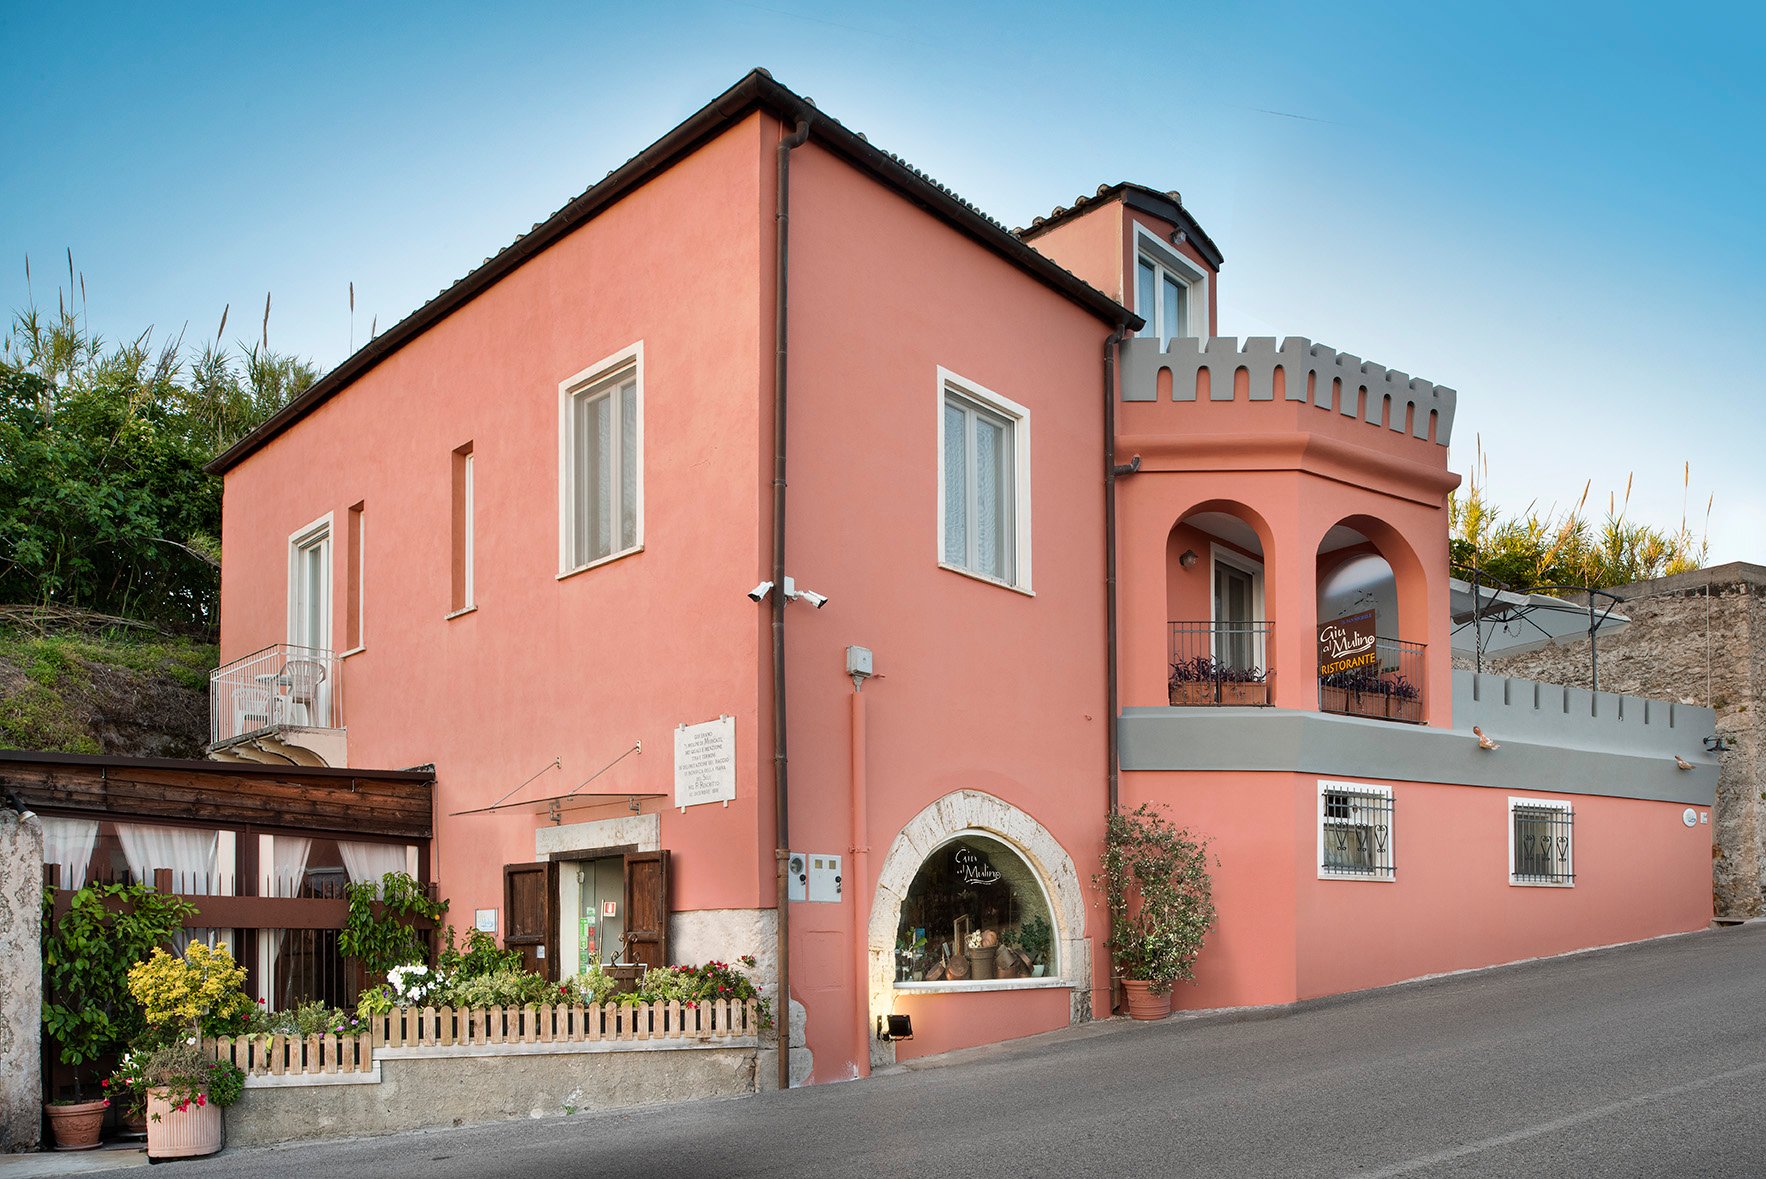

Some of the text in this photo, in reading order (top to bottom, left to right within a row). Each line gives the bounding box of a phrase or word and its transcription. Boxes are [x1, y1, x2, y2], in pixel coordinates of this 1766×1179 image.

[1322, 631, 1375, 657] al Mulino
[1321, 652, 1376, 675] RISTORANTE
[964, 863, 1001, 881] Mulino
